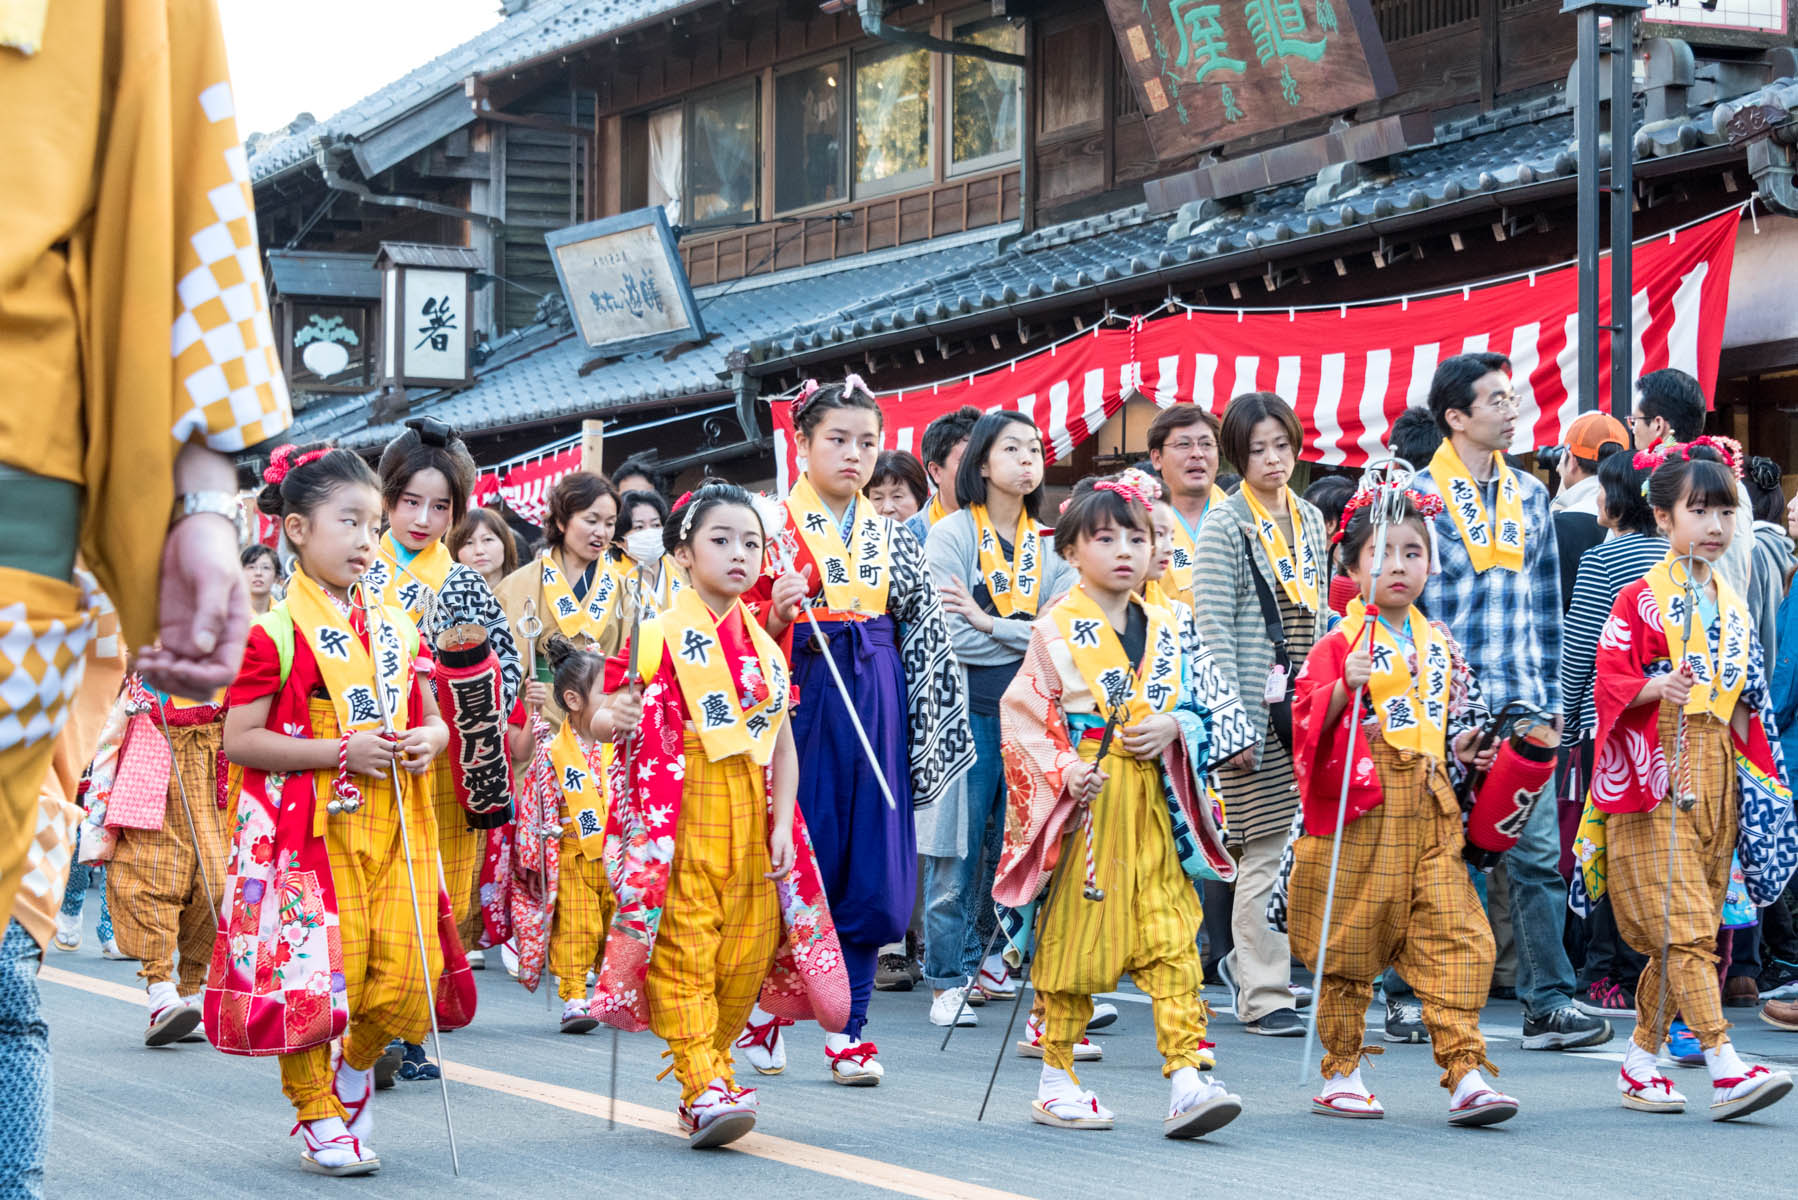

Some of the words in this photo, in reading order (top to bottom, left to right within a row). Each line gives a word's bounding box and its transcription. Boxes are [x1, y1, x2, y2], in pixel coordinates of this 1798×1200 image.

[414, 295, 457, 353] 箸
[1451, 479, 1488, 544] 志多町
[1500, 477, 1519, 545] 弁慶
[804, 513, 849, 584] 弁慶
[859, 519, 882, 587] 志多町
[981, 529, 1011, 595] 弁慶
[1018, 532, 1037, 595] 志多町
[1173, 548, 1192, 568] 慶
[589, 573, 614, 620] 志多町
[320, 627, 382, 722] 弁慶
[681, 629, 735, 728] 弁慶
[1147, 626, 1175, 710] 志多町
[1722, 609, 1742, 689] 志多町
[1429, 643, 1445, 728] 志多町
[564, 767, 602, 836] 弁慶
